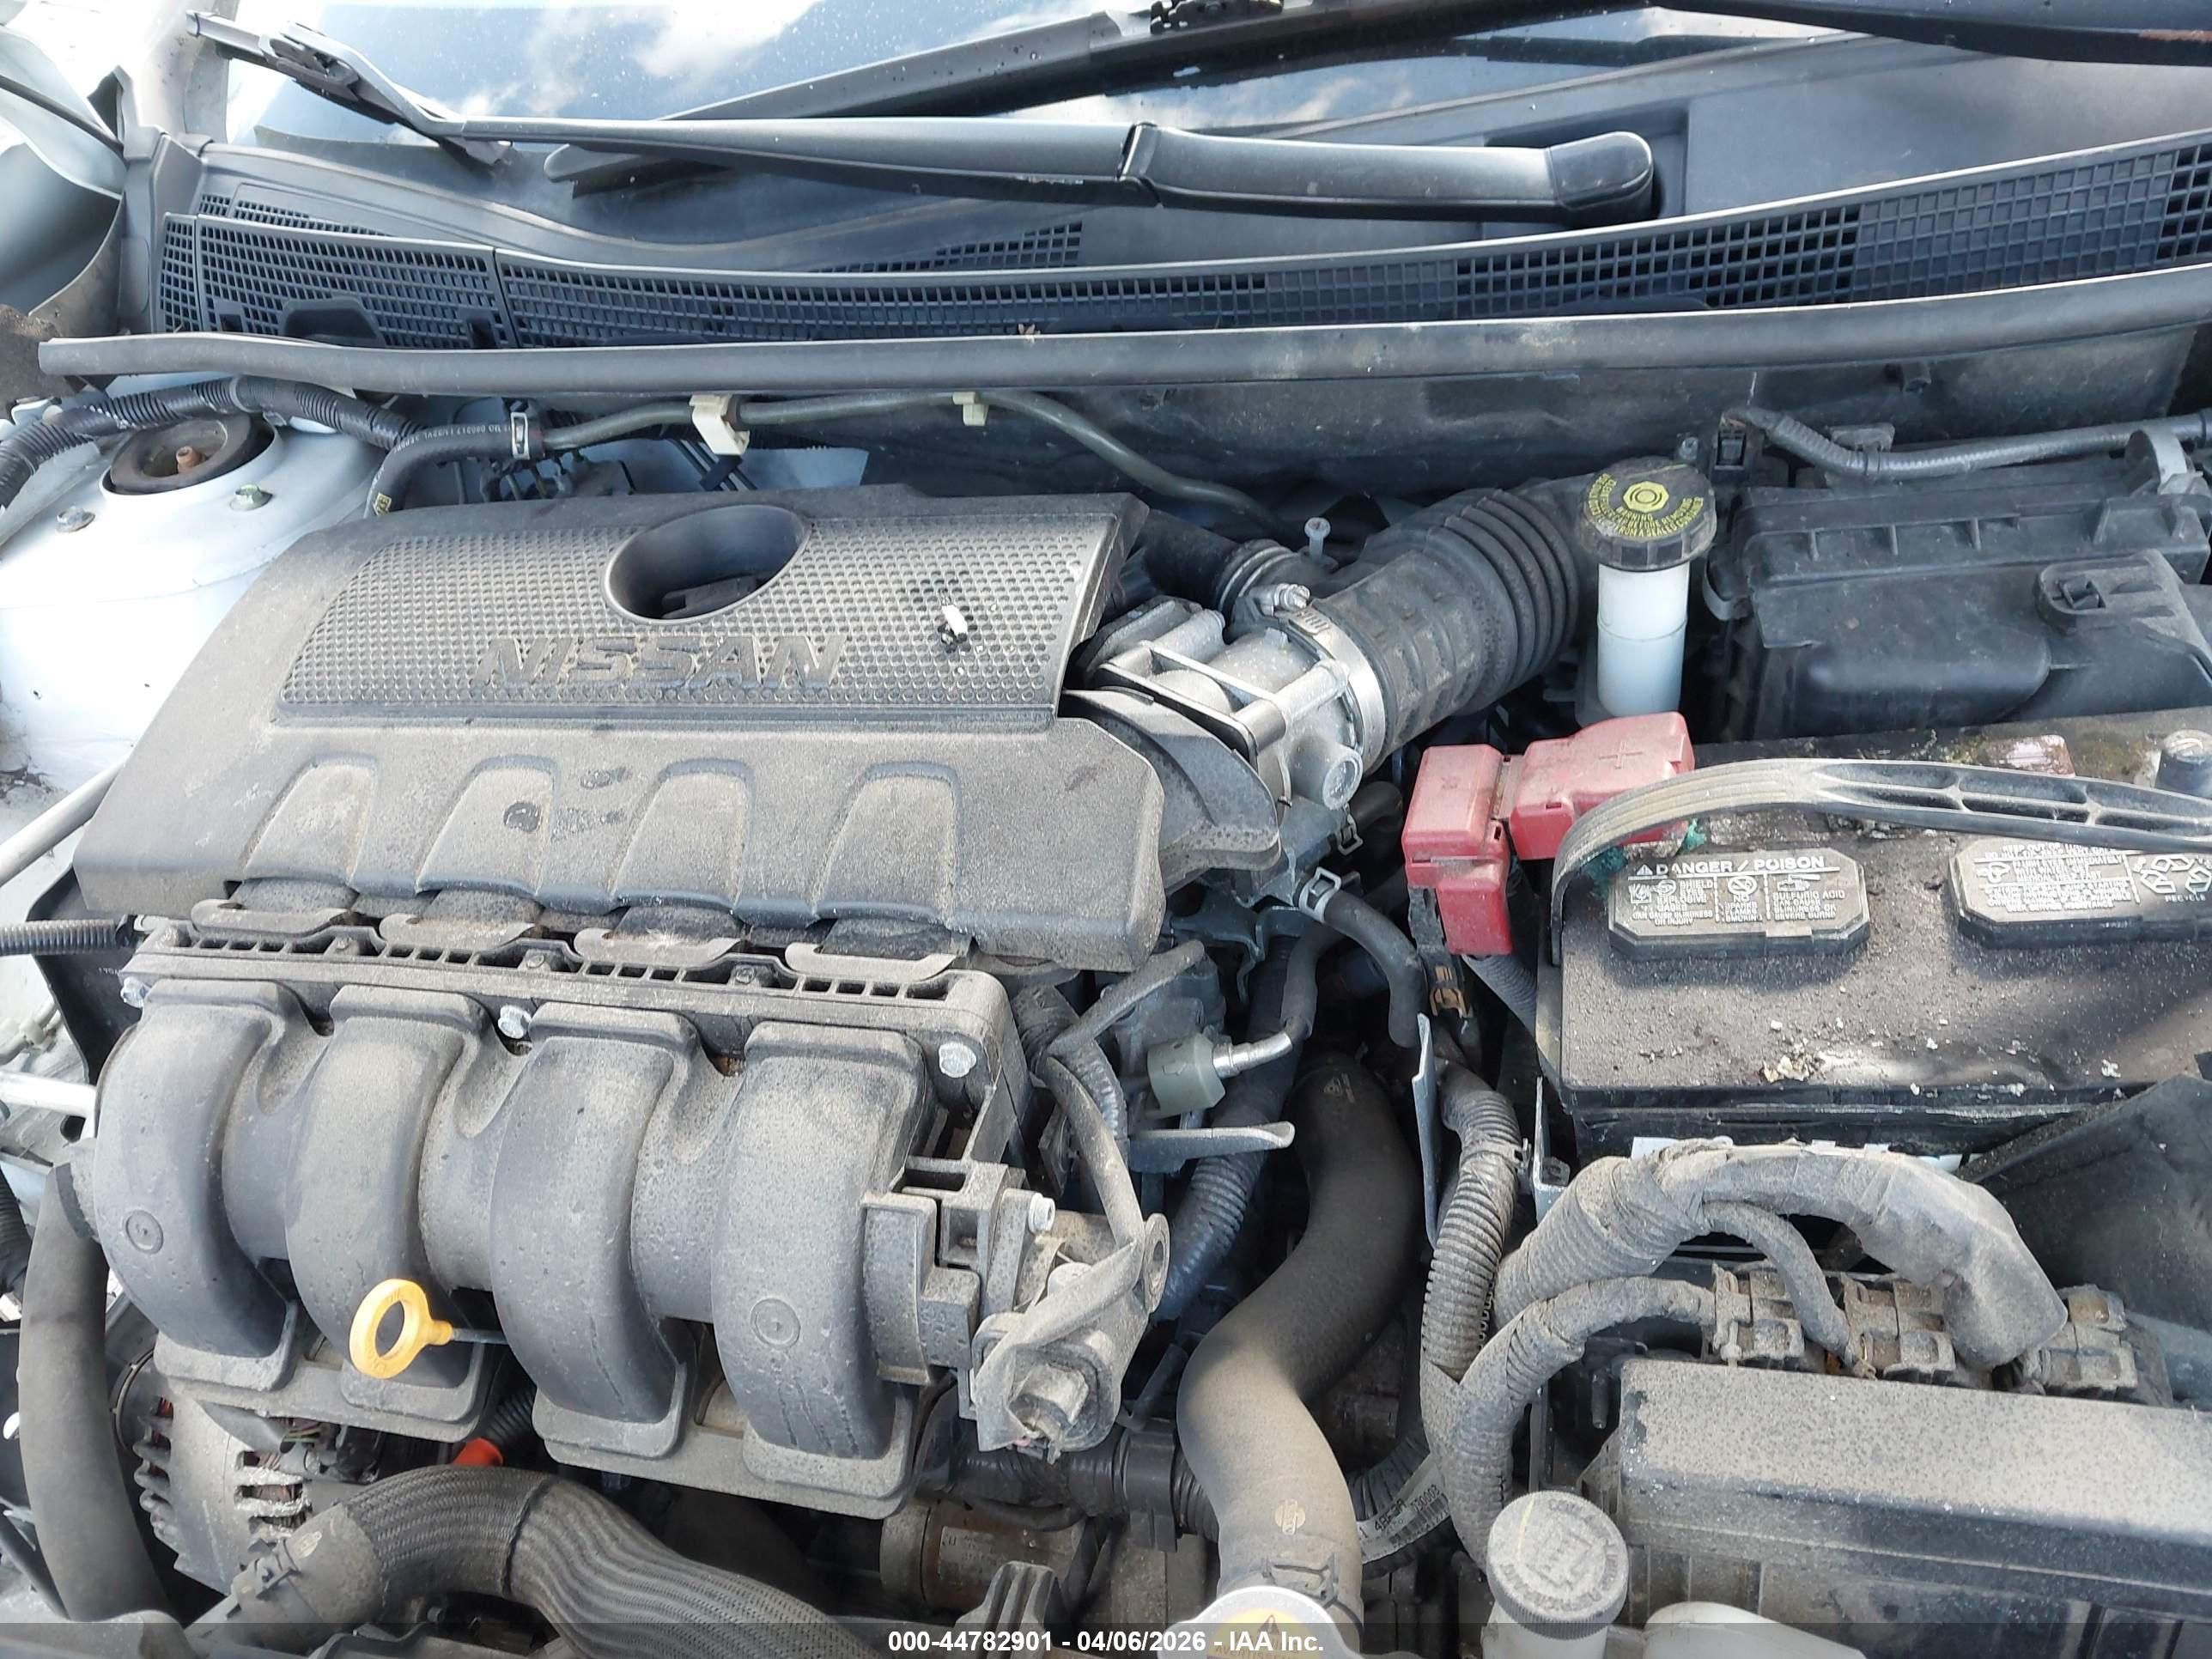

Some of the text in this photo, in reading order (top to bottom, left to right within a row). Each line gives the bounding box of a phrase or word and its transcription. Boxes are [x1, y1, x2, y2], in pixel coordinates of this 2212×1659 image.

[469, 635, 848, 688] NISSAN
[1656, 860, 1733, 874] DANGER
[1753, 856, 1825, 871] POISON
[1822, 890, 1845, 899] ACID
